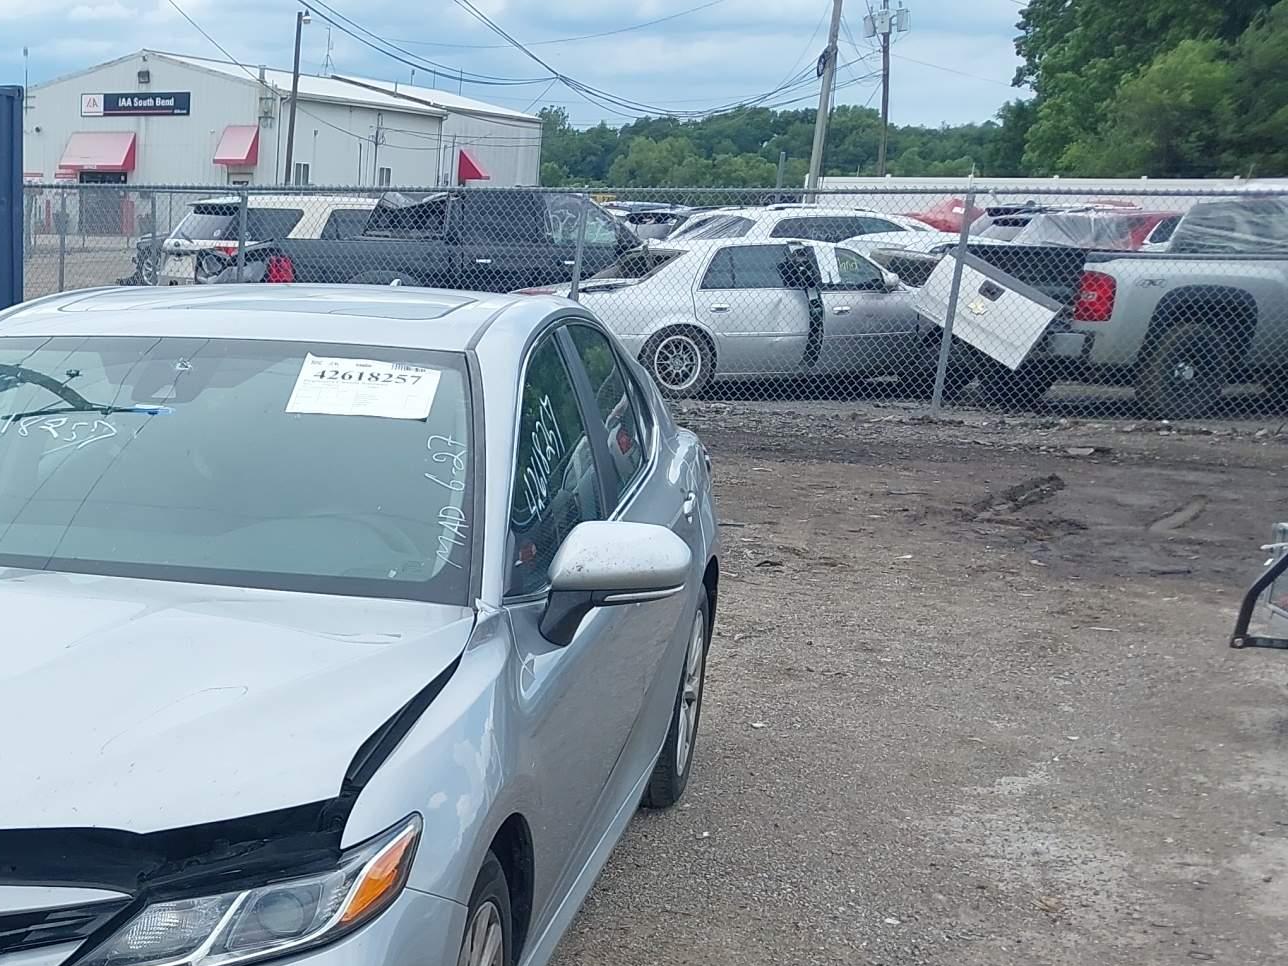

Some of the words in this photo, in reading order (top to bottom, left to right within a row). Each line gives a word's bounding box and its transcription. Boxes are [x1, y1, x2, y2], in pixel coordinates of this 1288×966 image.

[118, 97, 132, 107] IAA
[133, 97, 155, 107] South
[155, 97, 175, 106] Bend
[313, 369, 423, 385] 42618257
[436, 505, 469, 569] MAD
